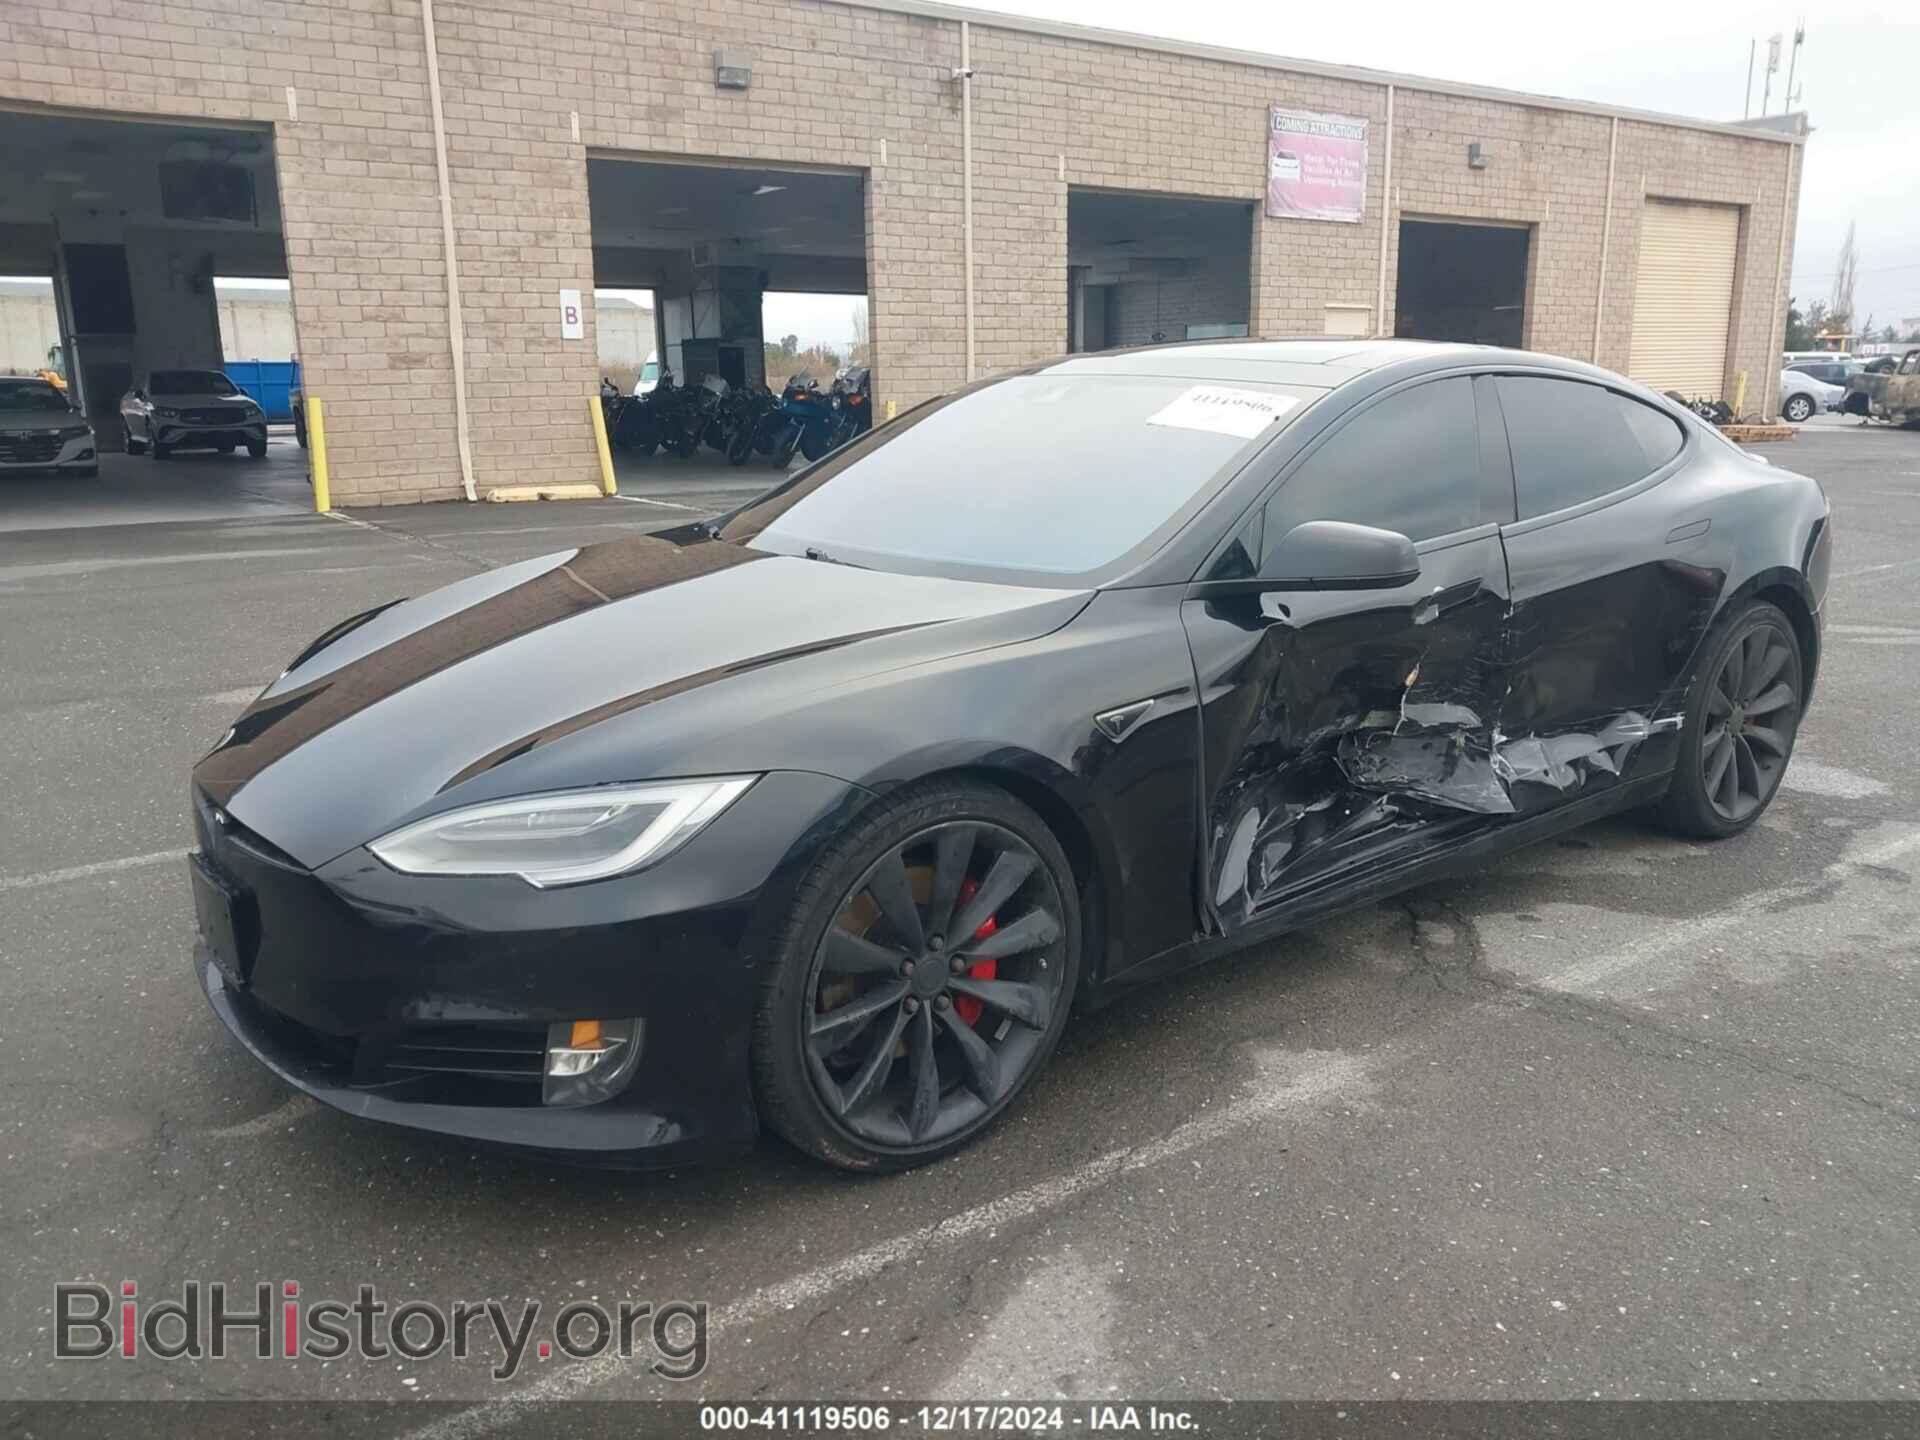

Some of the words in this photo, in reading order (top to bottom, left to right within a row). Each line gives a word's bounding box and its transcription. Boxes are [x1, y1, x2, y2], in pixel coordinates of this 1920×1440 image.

[1277, 116, 1309, 133] COMING
[1310, 121, 1363, 139] ATTRACTIONS
[565, 306, 578, 324] B
